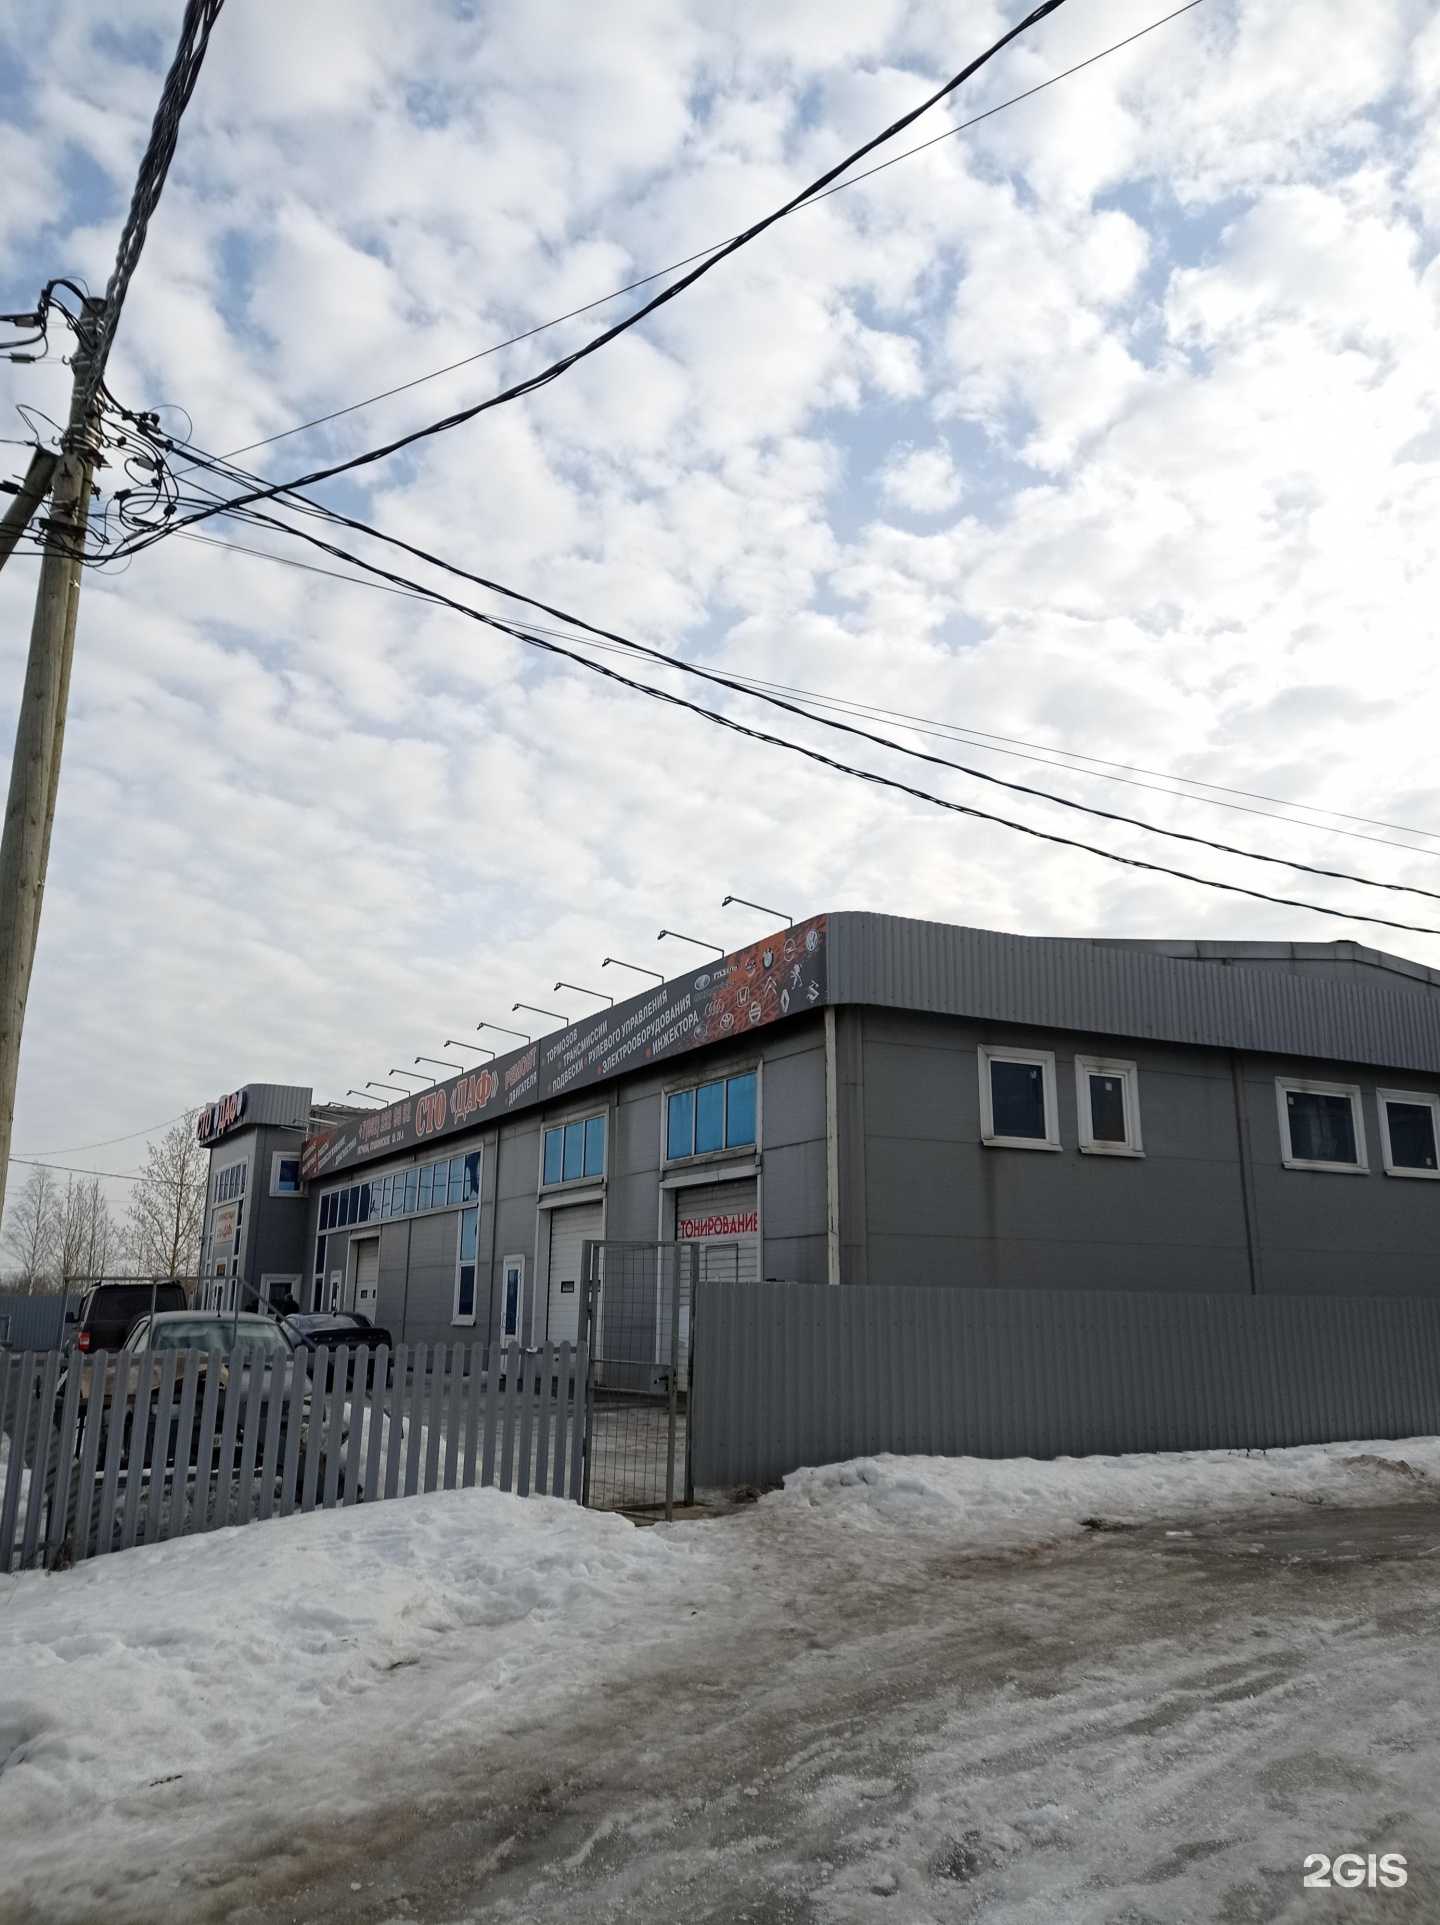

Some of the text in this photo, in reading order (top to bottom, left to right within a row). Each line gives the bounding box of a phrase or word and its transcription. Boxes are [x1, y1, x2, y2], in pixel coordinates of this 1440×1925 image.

[546, 1028, 578, 1065] ТОРМОЗОВ
[552, 989, 668, 1093] ПОДВЕСКИ РУЛЕВОГО УПРАВЛЕНИЯ
[563, 1019, 608, 1067] ТРАНСМИССИИ
[601, 993, 691, 1074] ЭЛЕКТРООБОРУДОВАНИЯ
[652, 1010, 699, 1057] ИНЖЕКТОРА
[415, 1088, 447, 1137] СТО
[680, 1211, 758, 1239] ТОНИРОВАНИЕ
